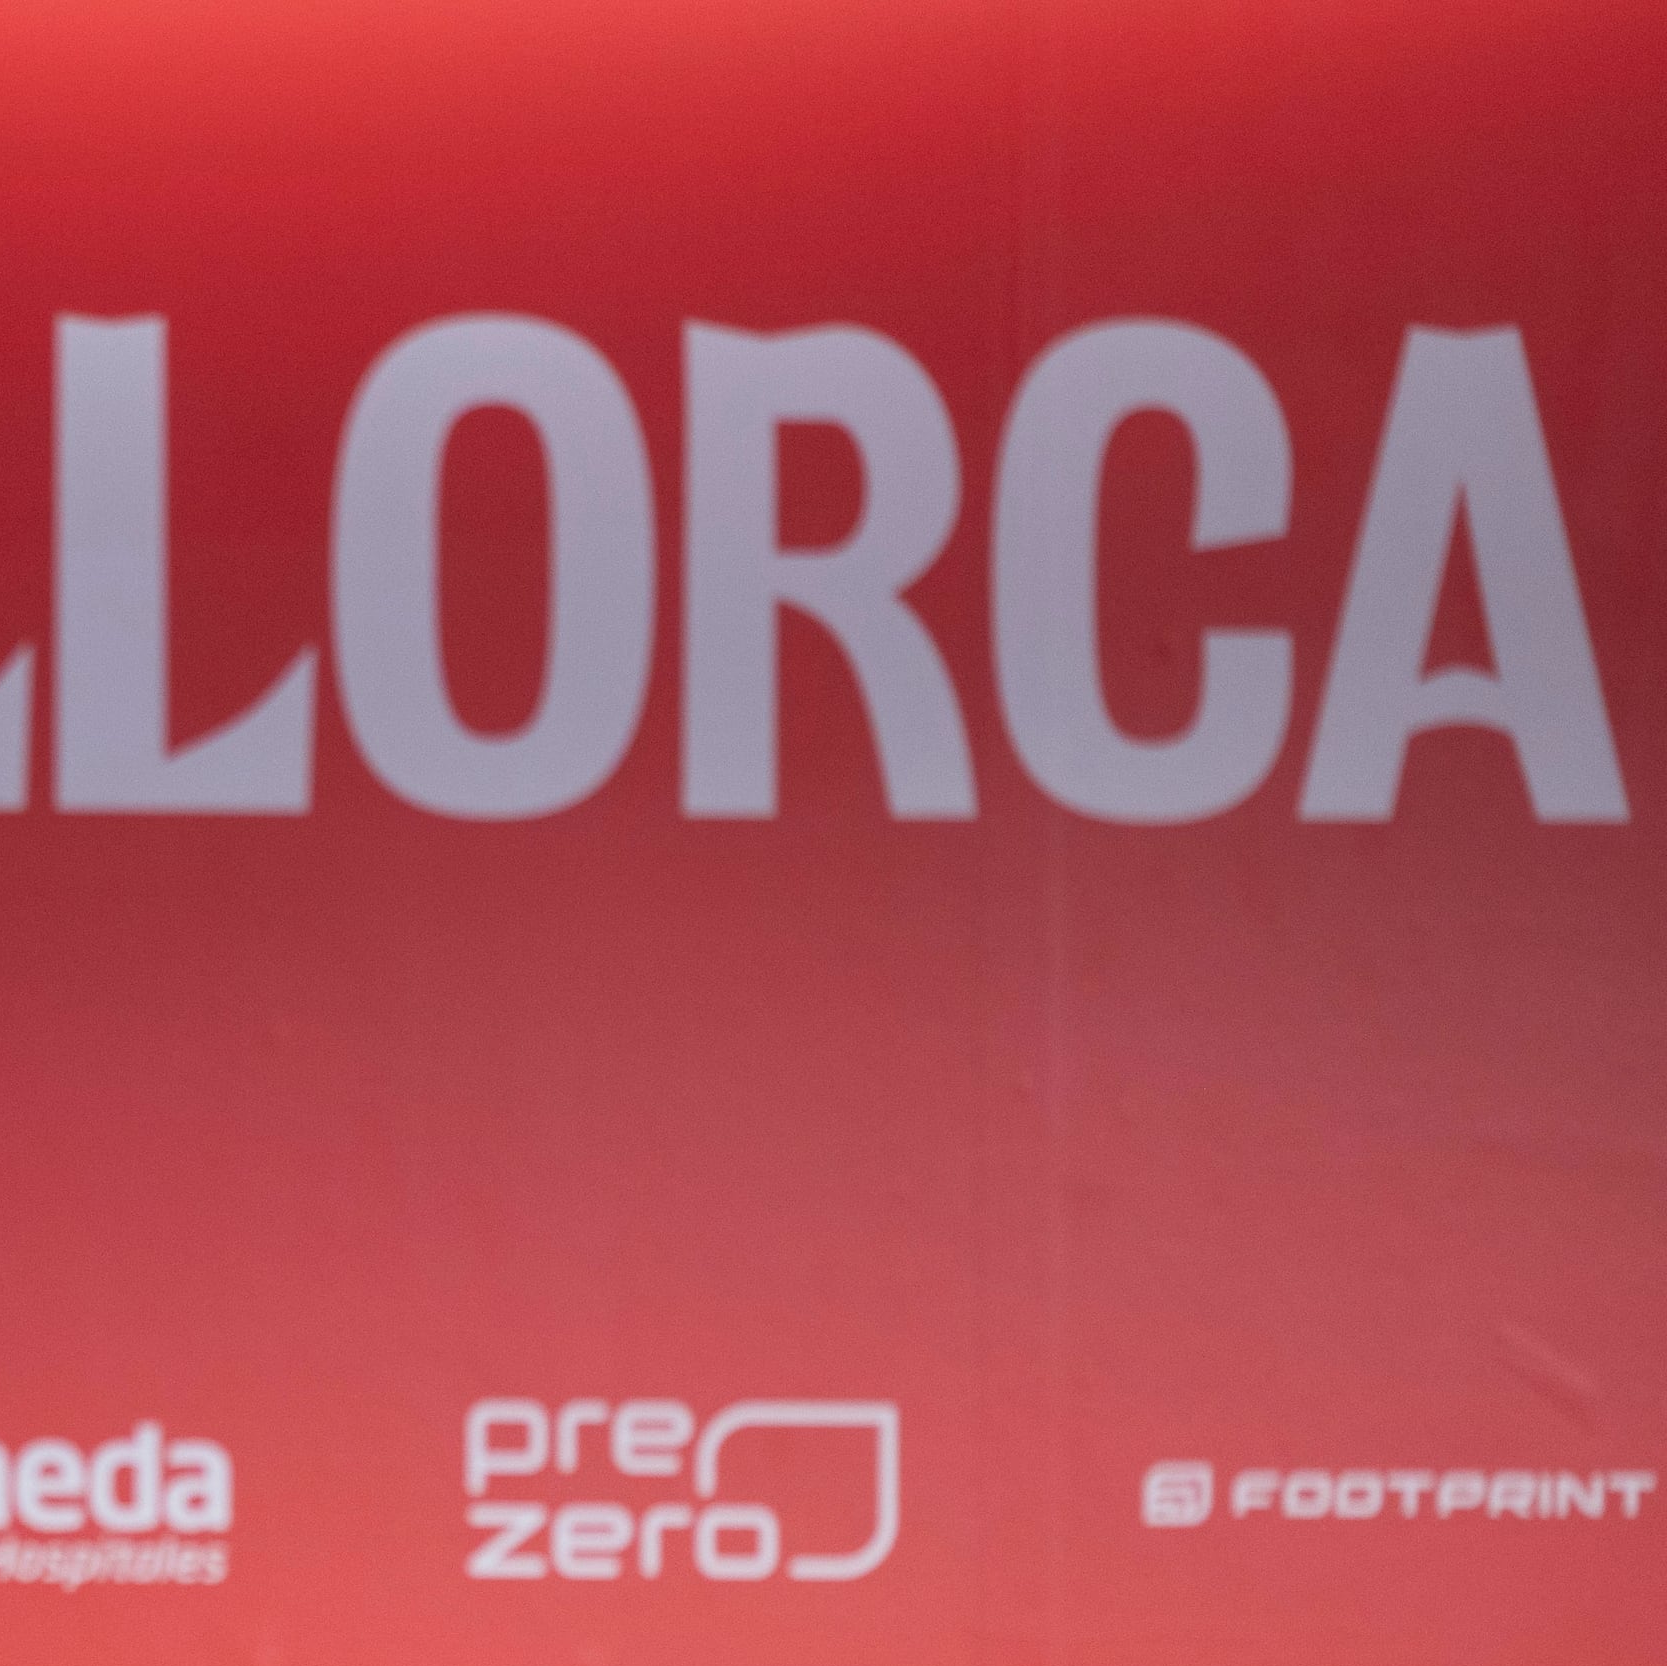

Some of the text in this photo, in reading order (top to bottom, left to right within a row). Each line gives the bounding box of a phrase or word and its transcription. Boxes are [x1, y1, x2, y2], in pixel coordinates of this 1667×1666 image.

[465, 1400, 698, 1496] pre
[1231, 1470, 1654, 1518] FOOTPRINT
[468, 1504, 779, 1580] zero
